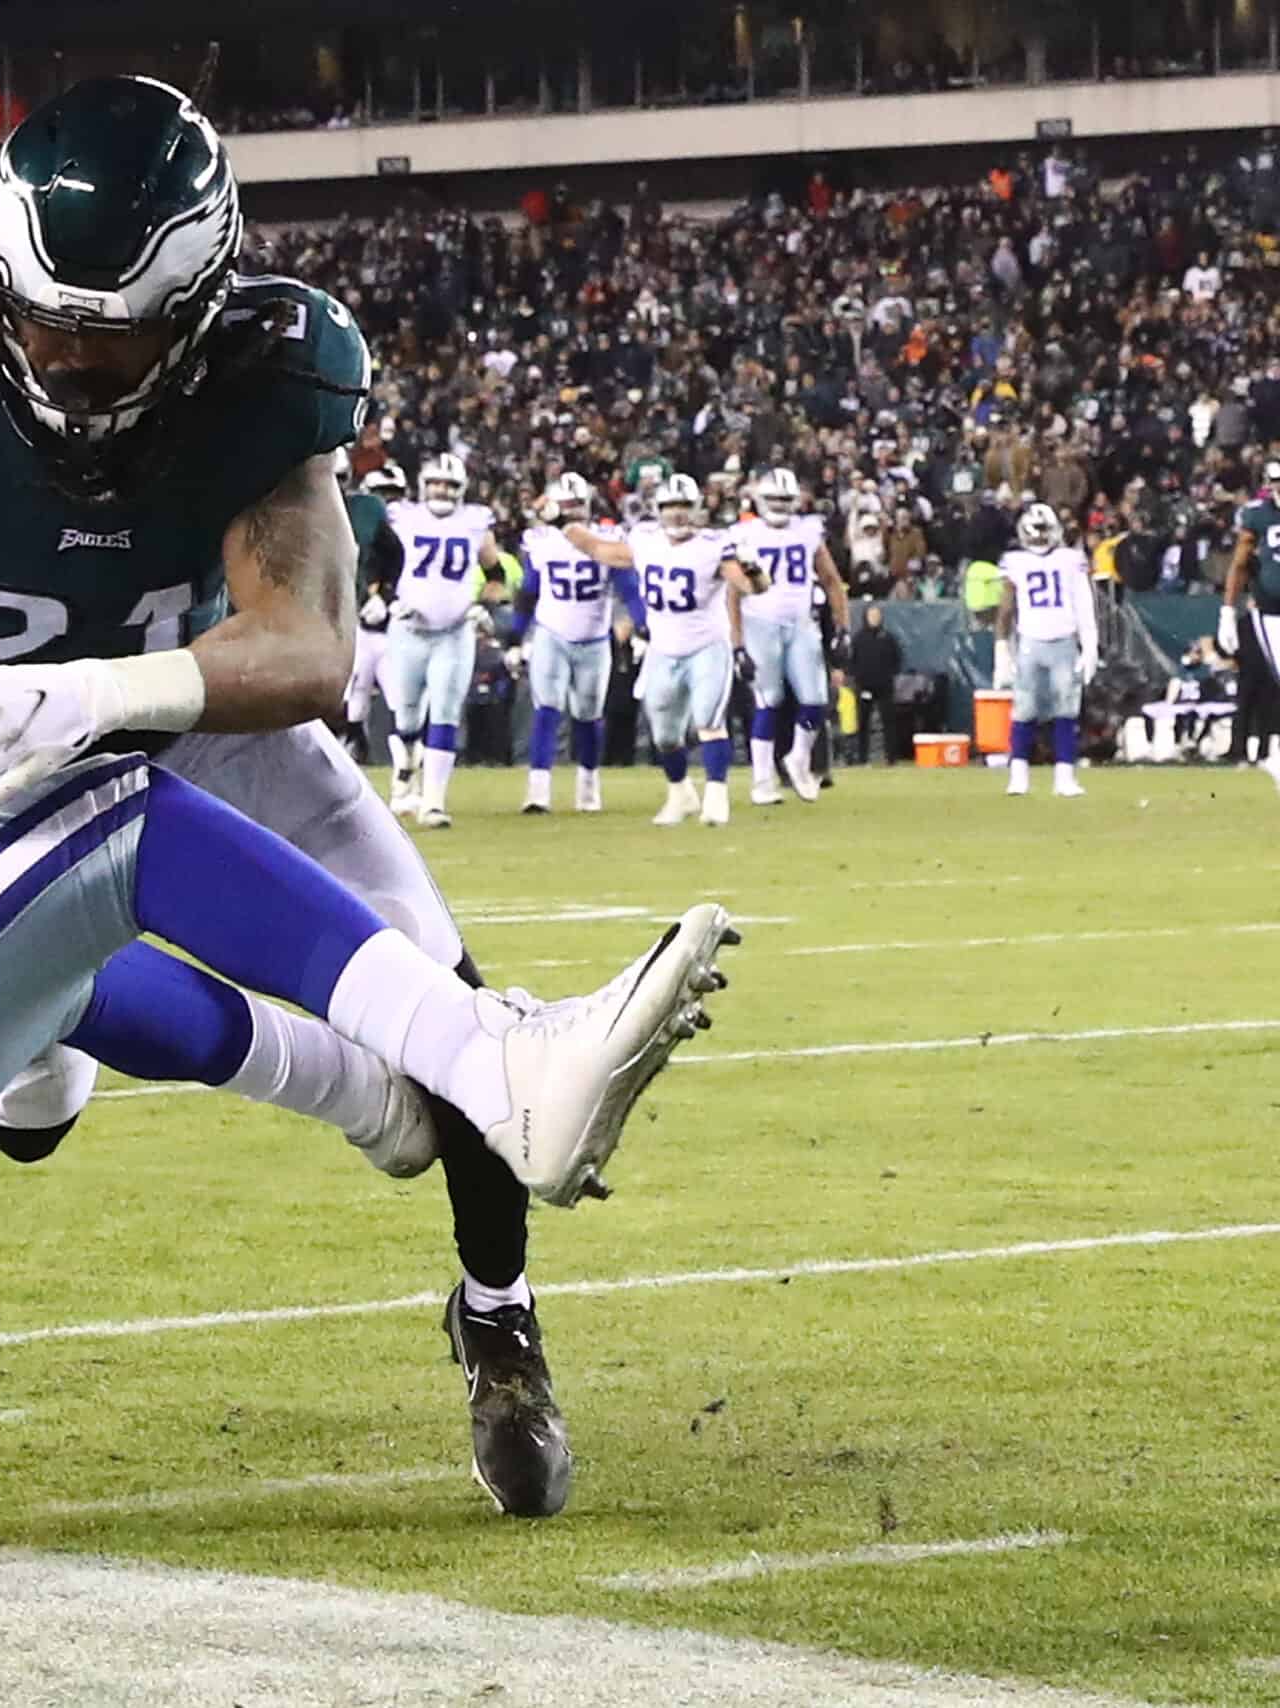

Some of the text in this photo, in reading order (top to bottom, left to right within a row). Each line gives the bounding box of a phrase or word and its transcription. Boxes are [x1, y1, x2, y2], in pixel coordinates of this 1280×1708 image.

[57, 529, 132, 551] EAGLES
[412, 535, 470, 581] 70
[547, 560, 601, 602] 52
[757, 544, 807, 585] 78
[645, 564, 698, 612] 63
[1026, 570, 1063, 608] 21
